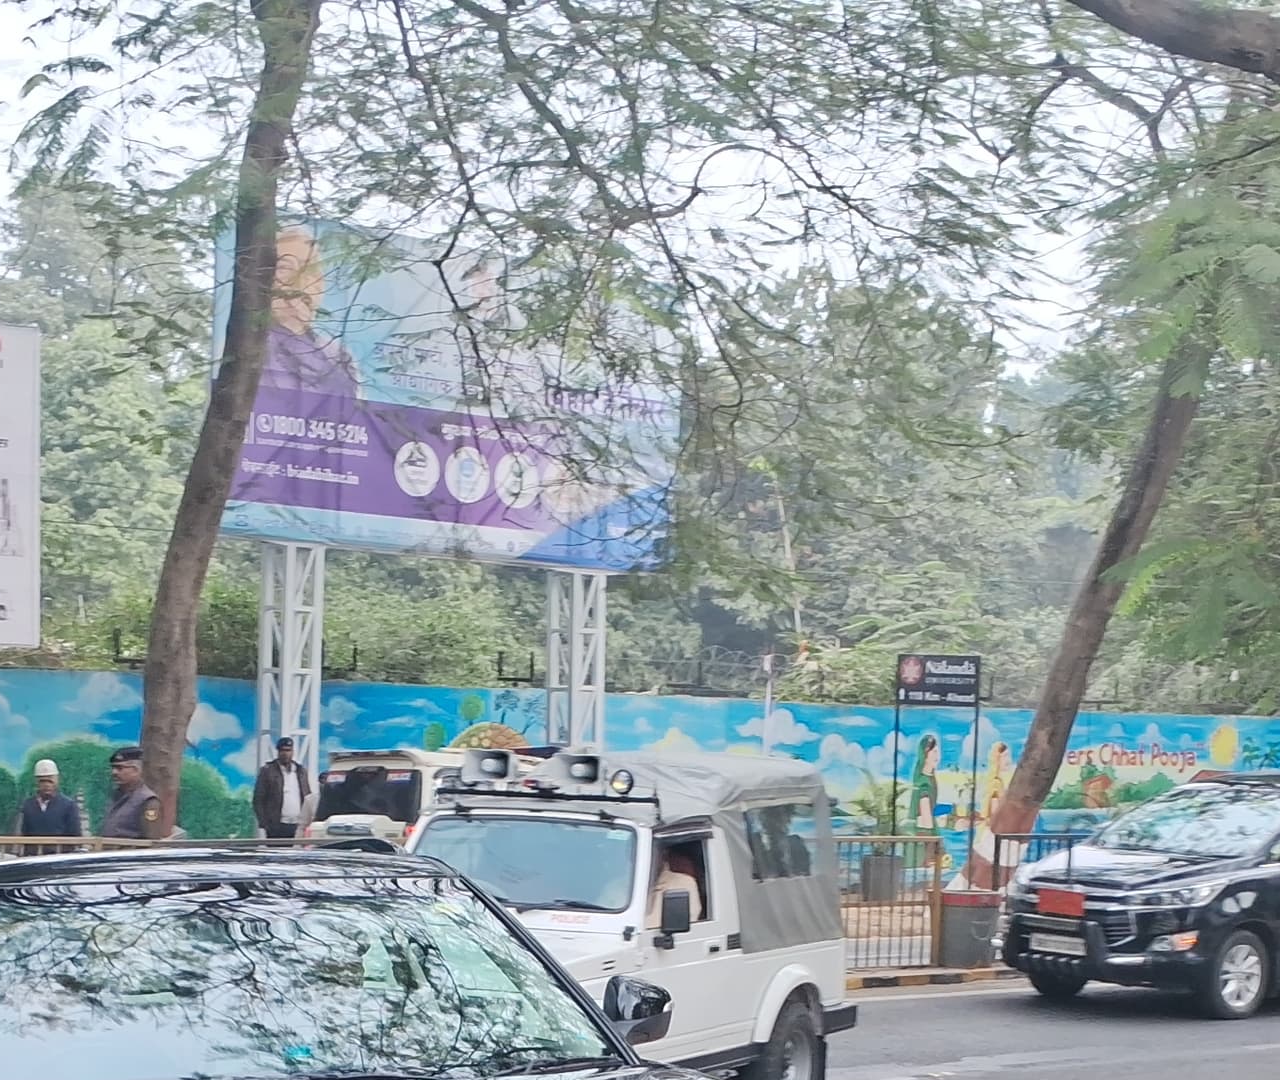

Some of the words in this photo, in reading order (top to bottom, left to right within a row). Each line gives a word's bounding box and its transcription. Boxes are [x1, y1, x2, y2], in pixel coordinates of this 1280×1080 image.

[307, 420, 335, 441] 345
[1099, 743, 1145, 767] Chhat
[1151, 742, 1196, 774] Pooja
